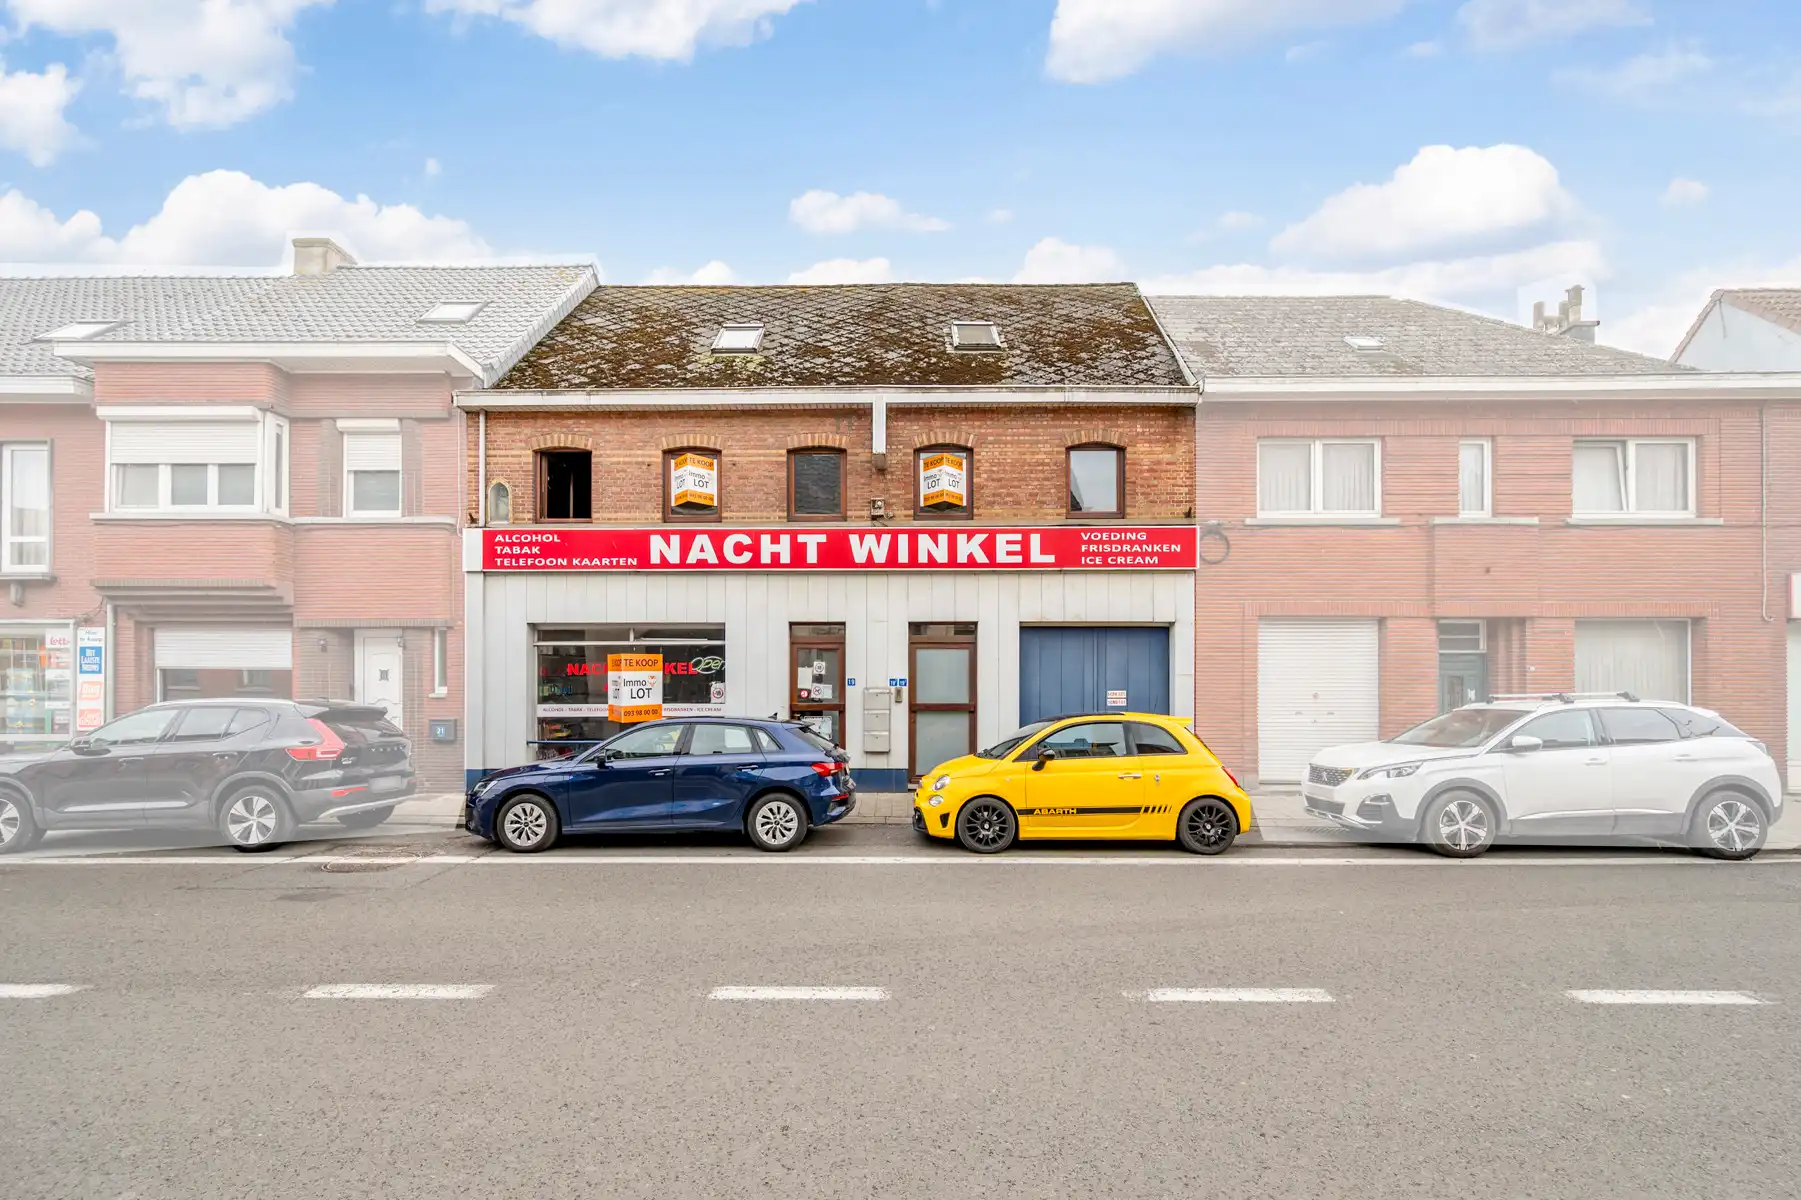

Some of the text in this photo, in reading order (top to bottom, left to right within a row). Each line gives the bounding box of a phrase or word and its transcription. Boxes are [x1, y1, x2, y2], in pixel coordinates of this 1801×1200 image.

[697, 459, 713, 467] KOOP
[689, 469, 705, 480] Immo
[694, 478, 709, 488] LOT
[927, 478, 940, 489] LOT
[948, 478, 960, 488] LOT
[494, 534, 561, 543] ALCOHOL
[1081, 532, 1147, 541] VOEDING
[494, 546, 541, 555] TABAK
[649, 532, 1056, 565] NACHT WINKEL
[1081, 543, 1181, 553] FRISDRANKEN
[495, 557, 638, 567] TELEFOON KAARTEN
[1081, 556, 1159, 565] ICE CREAM
[624, 658, 634, 667] TE
[636, 658, 659, 667] KOOP
[567, 662, 698, 676] NAC KEL
[623, 678, 647, 687] Immo
[630, 688, 653, 700] LOT
[623, 709, 635, 717] 093
[651, 707, 659, 715] 00
[1033, 808, 1077, 816] ABARTH
